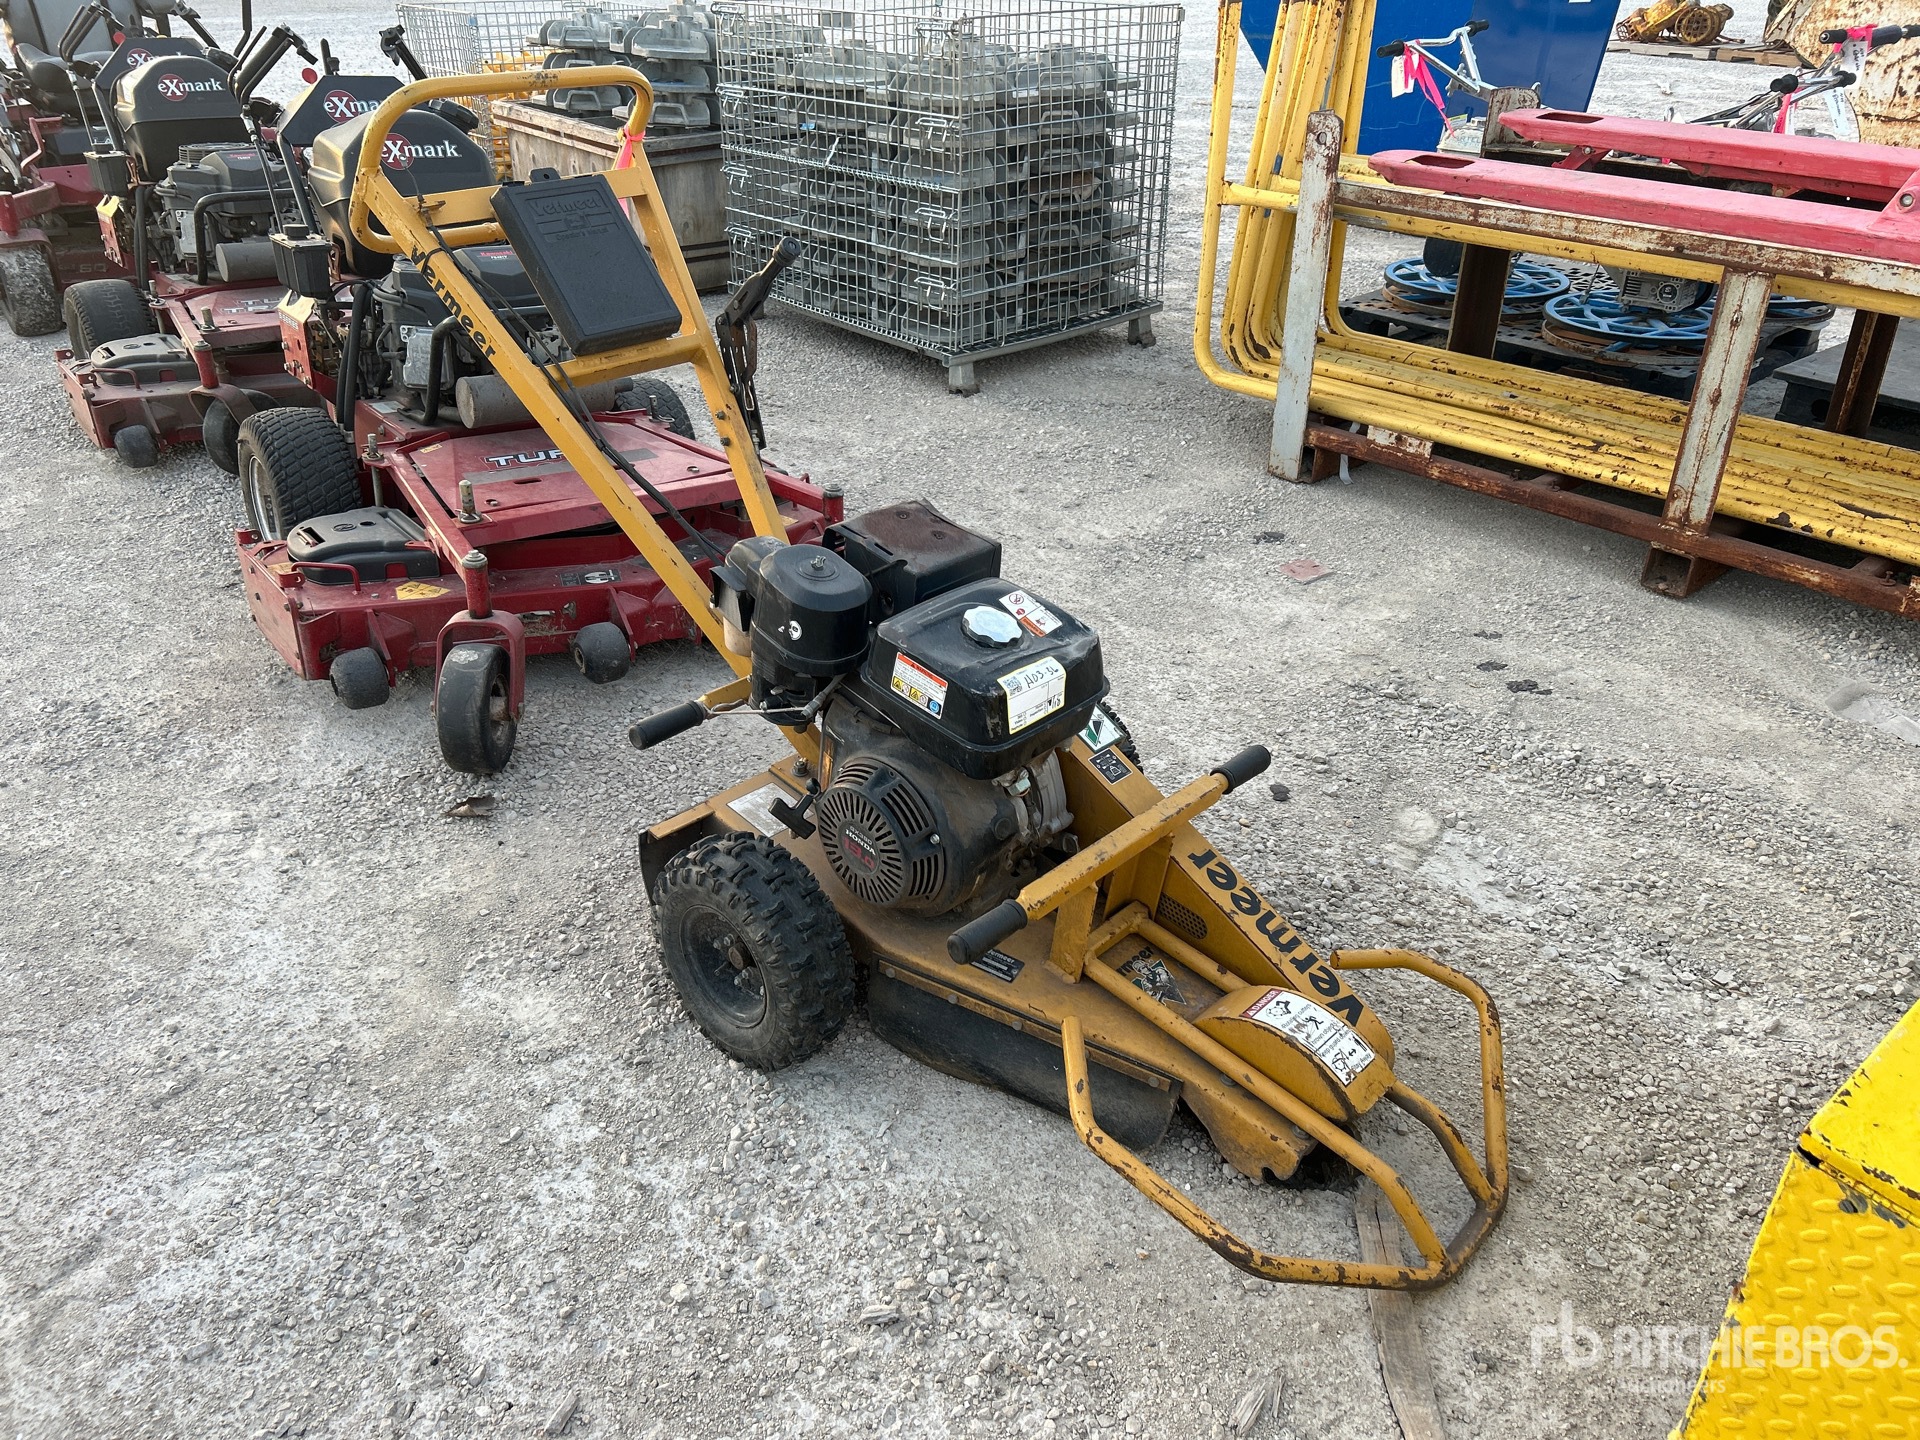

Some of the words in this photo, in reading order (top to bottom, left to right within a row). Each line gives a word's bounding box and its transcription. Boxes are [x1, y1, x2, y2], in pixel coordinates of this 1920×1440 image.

[158, 78, 223, 96] eXmark
[323, 96, 380, 118] eXma
[528, 197, 602, 217] Vermeer
[410, 244, 497, 359] Vermeer
[842, 836, 876, 870] 13.0
[845, 829, 876, 856] HONDA
[1187, 849, 1364, 1027] Vermeer
[1251, 989, 1280, 1014] DANGER
